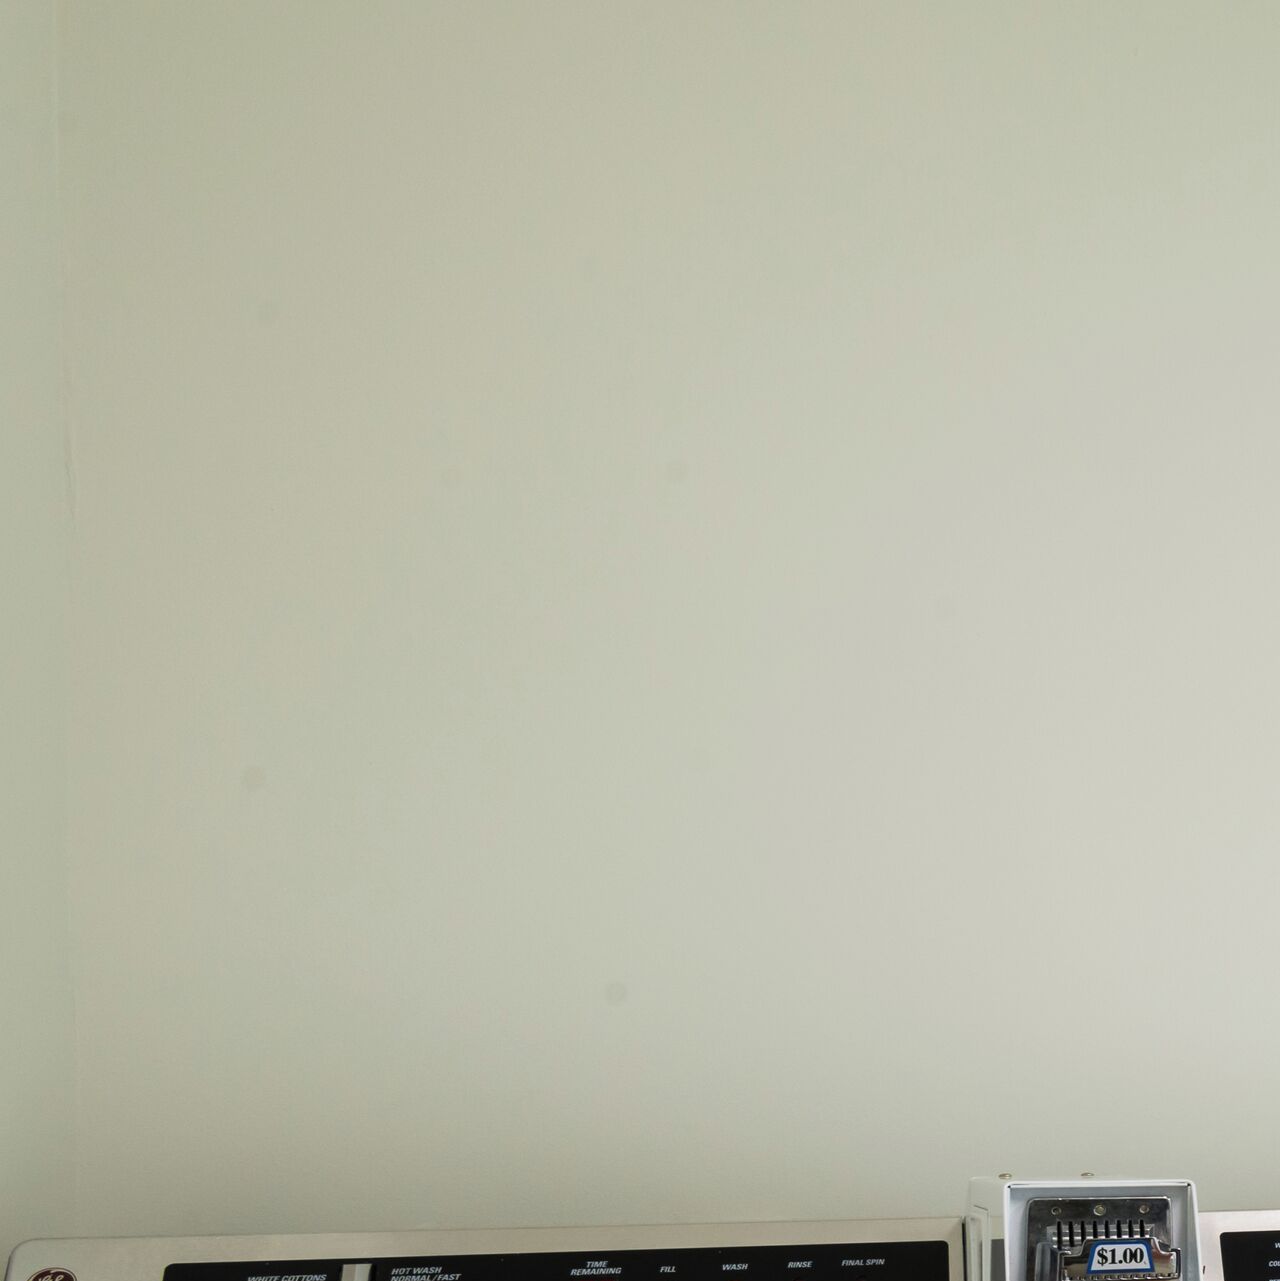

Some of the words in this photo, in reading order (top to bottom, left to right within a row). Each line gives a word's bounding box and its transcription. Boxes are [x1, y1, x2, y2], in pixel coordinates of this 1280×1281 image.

[1097, 1247, 1144, 1267] $1.00
[722, 1263, 749, 1271] WASH
[841, 1259, 864, 1267] FINAL
[865, 1258, 885, 1266] SPIN
[412, 1266, 442, 1274] WASH
[570, 1267, 622, 1276] REMAINING
